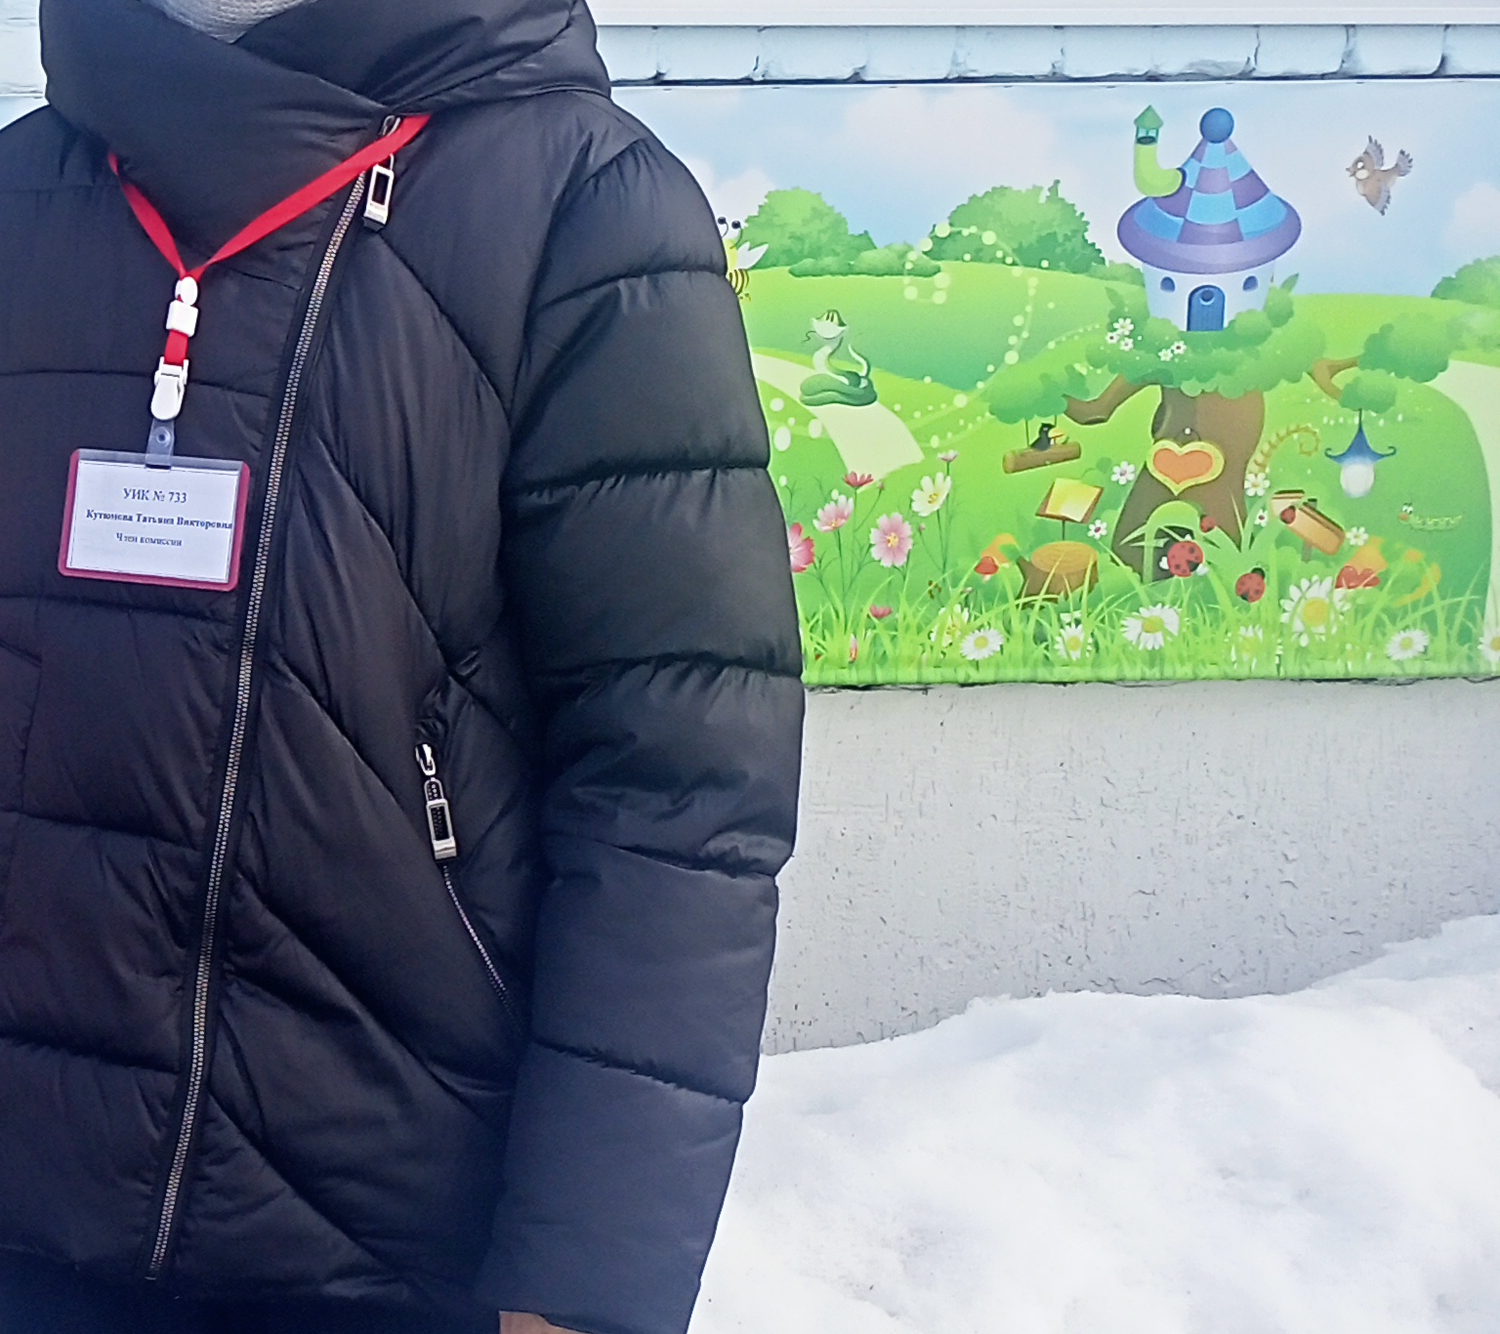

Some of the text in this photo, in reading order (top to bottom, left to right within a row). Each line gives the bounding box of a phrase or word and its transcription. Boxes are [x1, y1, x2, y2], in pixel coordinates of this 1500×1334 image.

[123, 488, 187, 503] УИК № 733
